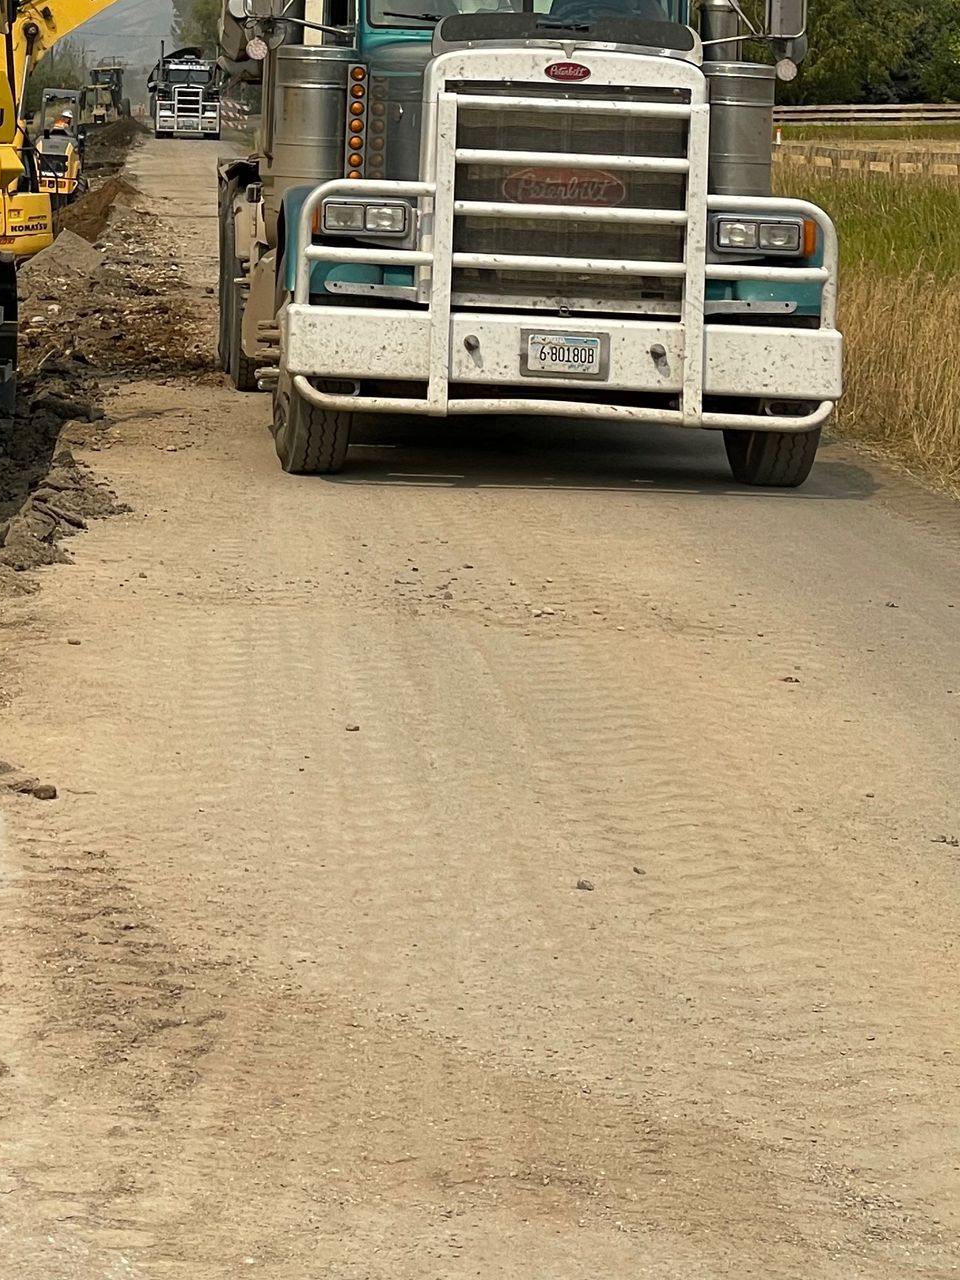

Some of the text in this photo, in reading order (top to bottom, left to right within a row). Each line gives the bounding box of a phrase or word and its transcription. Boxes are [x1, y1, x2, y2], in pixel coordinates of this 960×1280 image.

[550, 64, 587, 77] Peterbilt
[517, 173, 617, 201] Peterbilt
[10, 222, 48, 232] KOMATSU
